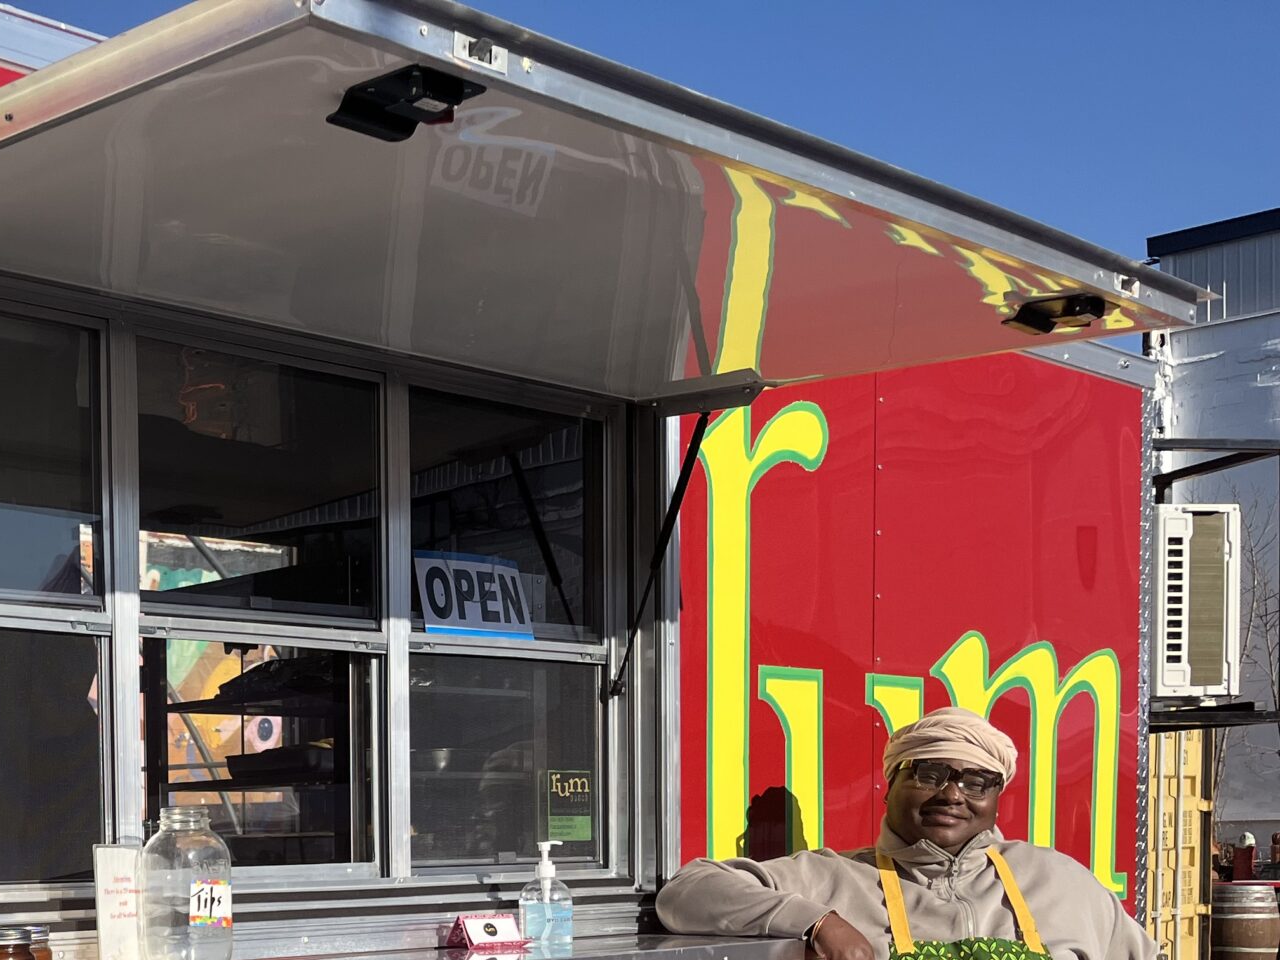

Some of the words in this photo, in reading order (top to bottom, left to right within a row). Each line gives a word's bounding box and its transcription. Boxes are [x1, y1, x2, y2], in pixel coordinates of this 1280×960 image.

[425, 566, 525, 625] OPEN
[550, 773, 590, 797] rum
[191, 886, 223, 919] Tips
